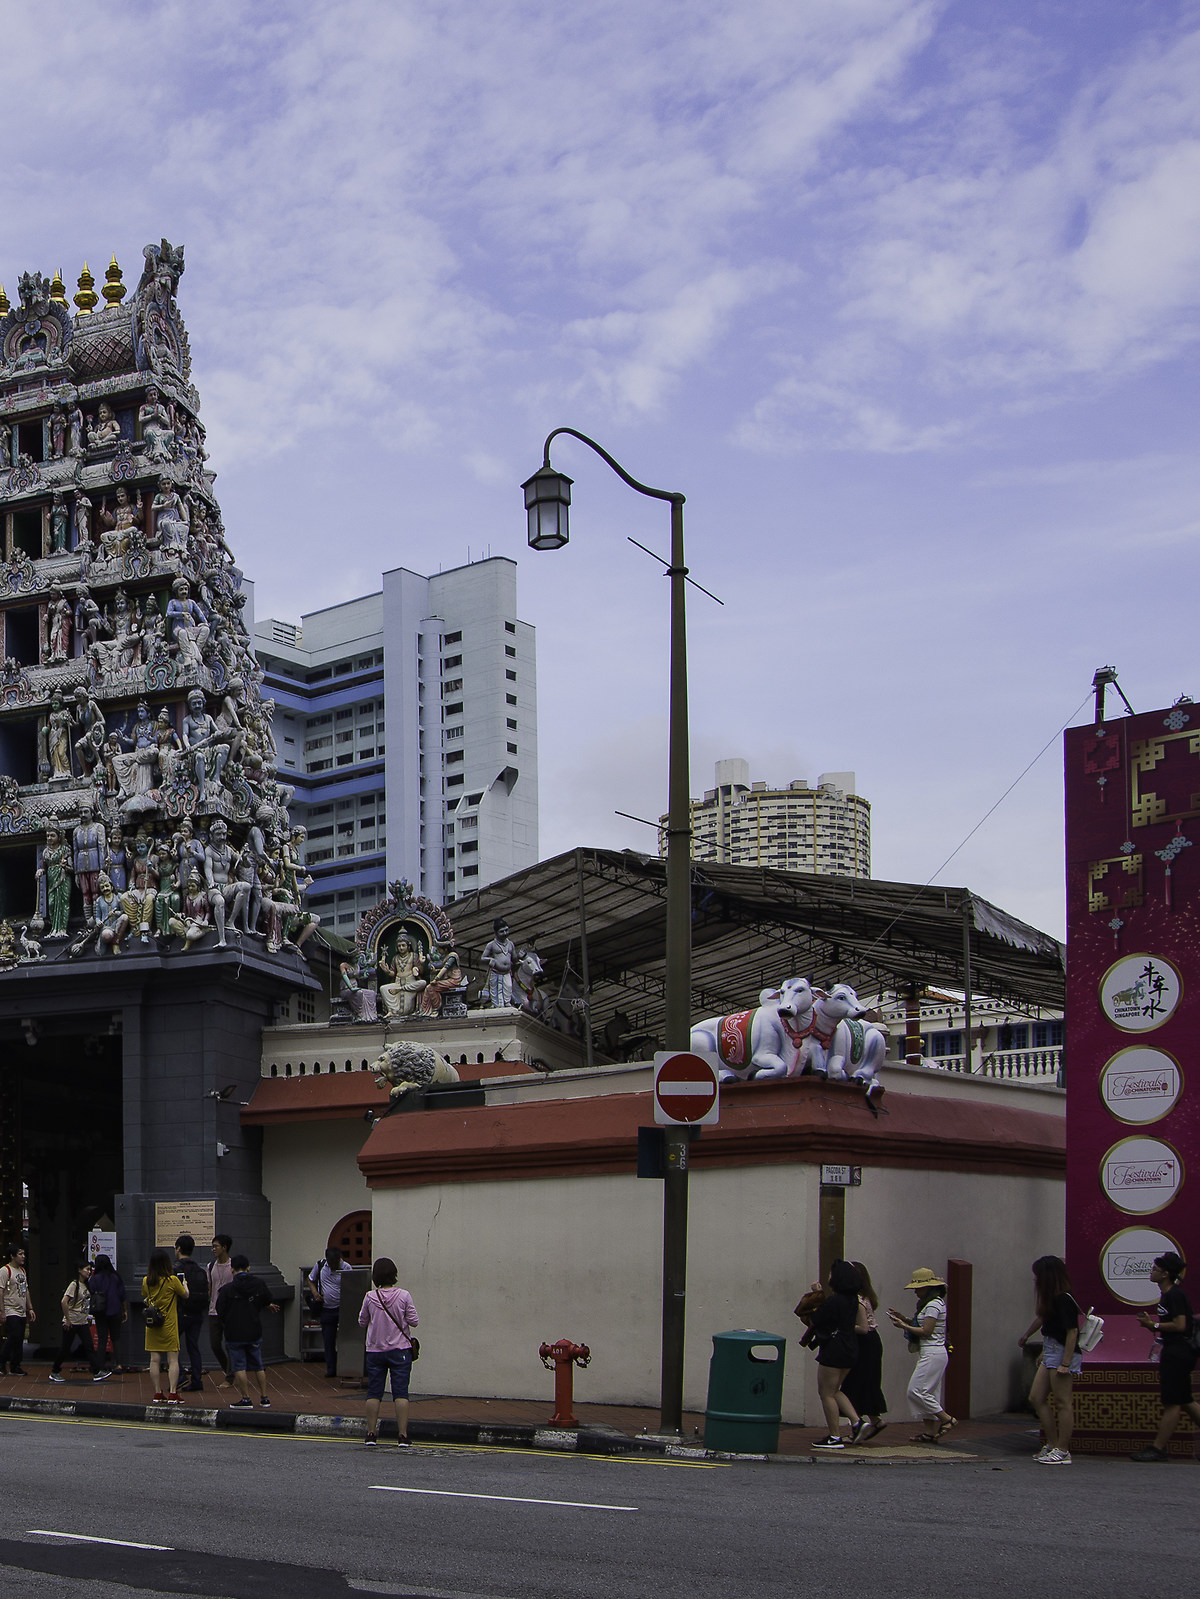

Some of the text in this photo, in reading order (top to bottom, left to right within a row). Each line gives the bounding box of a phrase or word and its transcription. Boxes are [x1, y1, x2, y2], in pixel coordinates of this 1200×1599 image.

[1138, 960, 1169, 1020] 牛车水
[1112, 1072, 1163, 1097] Festivals
[1112, 1163, 1163, 1186] Festivals
